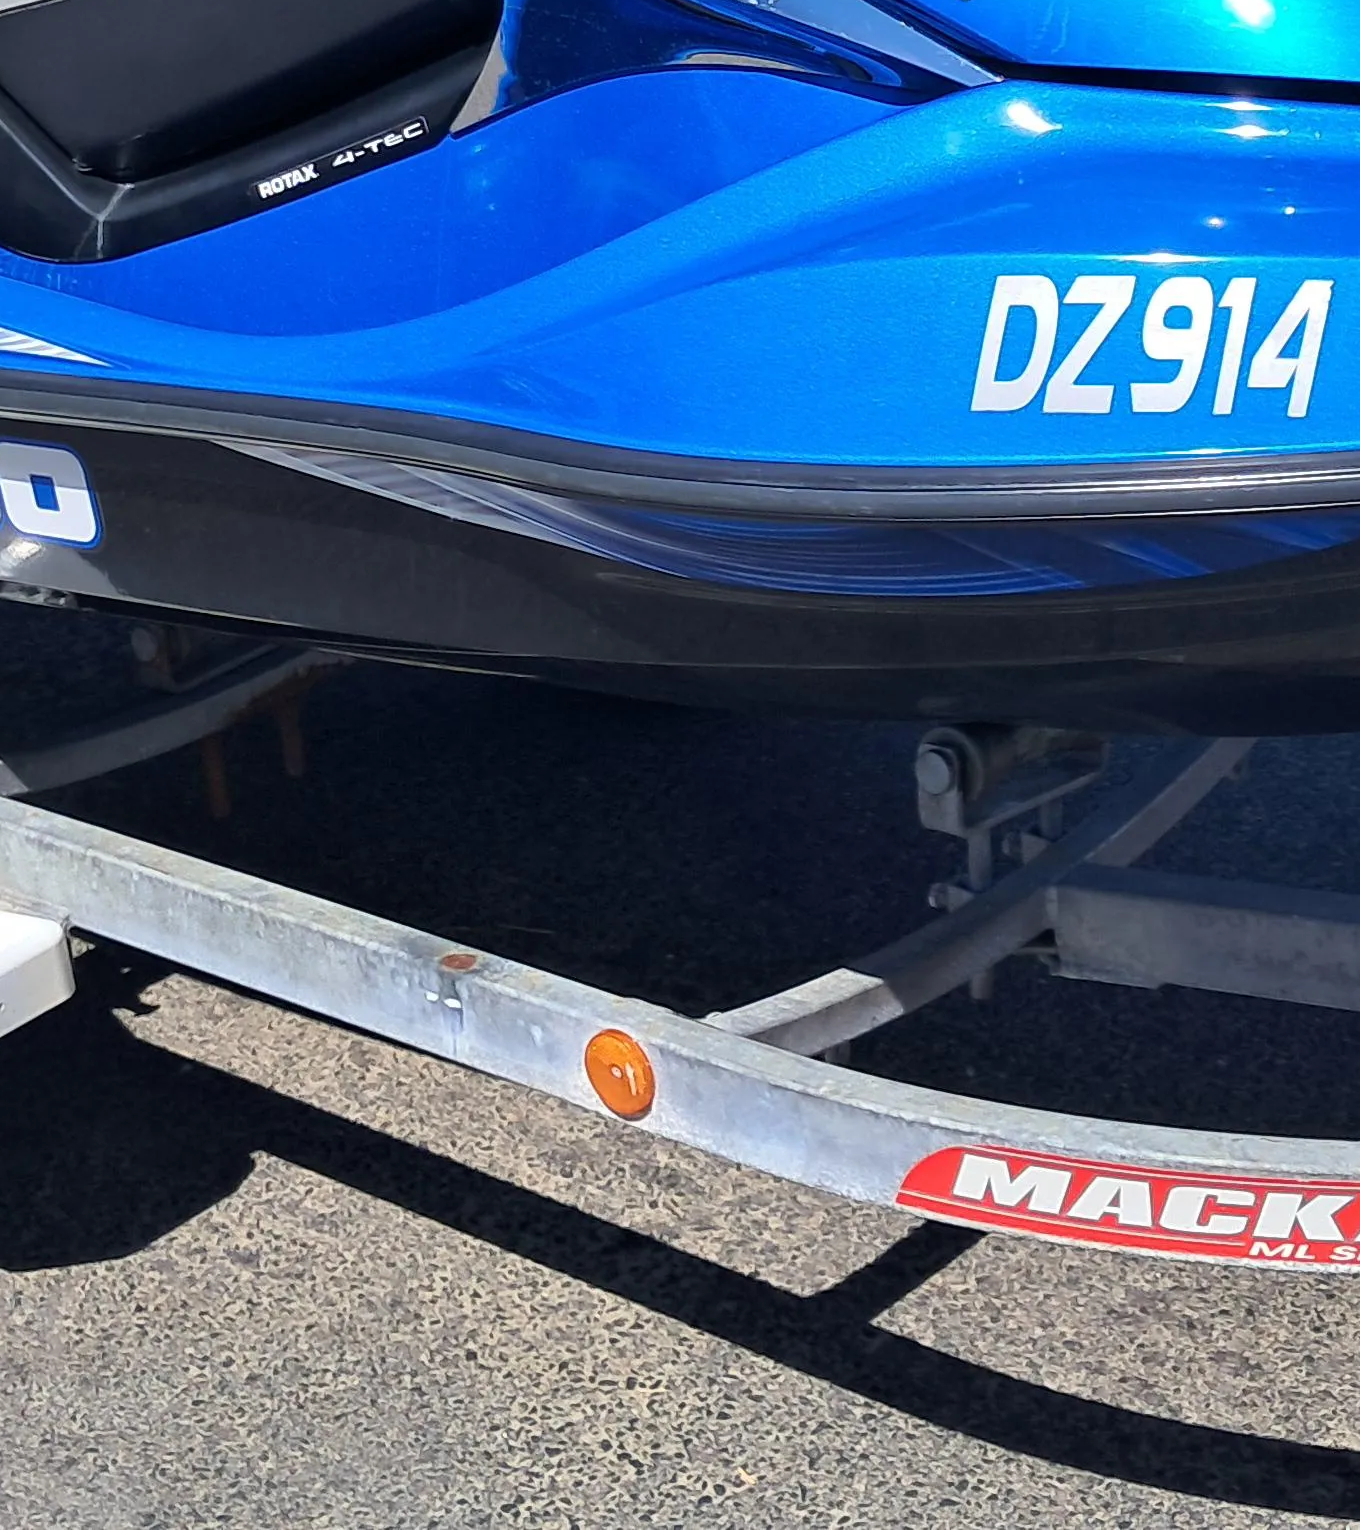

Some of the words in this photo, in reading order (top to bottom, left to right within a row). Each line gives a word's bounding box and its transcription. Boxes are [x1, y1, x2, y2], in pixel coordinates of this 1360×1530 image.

[258, 163, 319, 199] ROTAX
[332, 122, 424, 167] 4-TEC
[1249, 1239, 1312, 1260] ML
